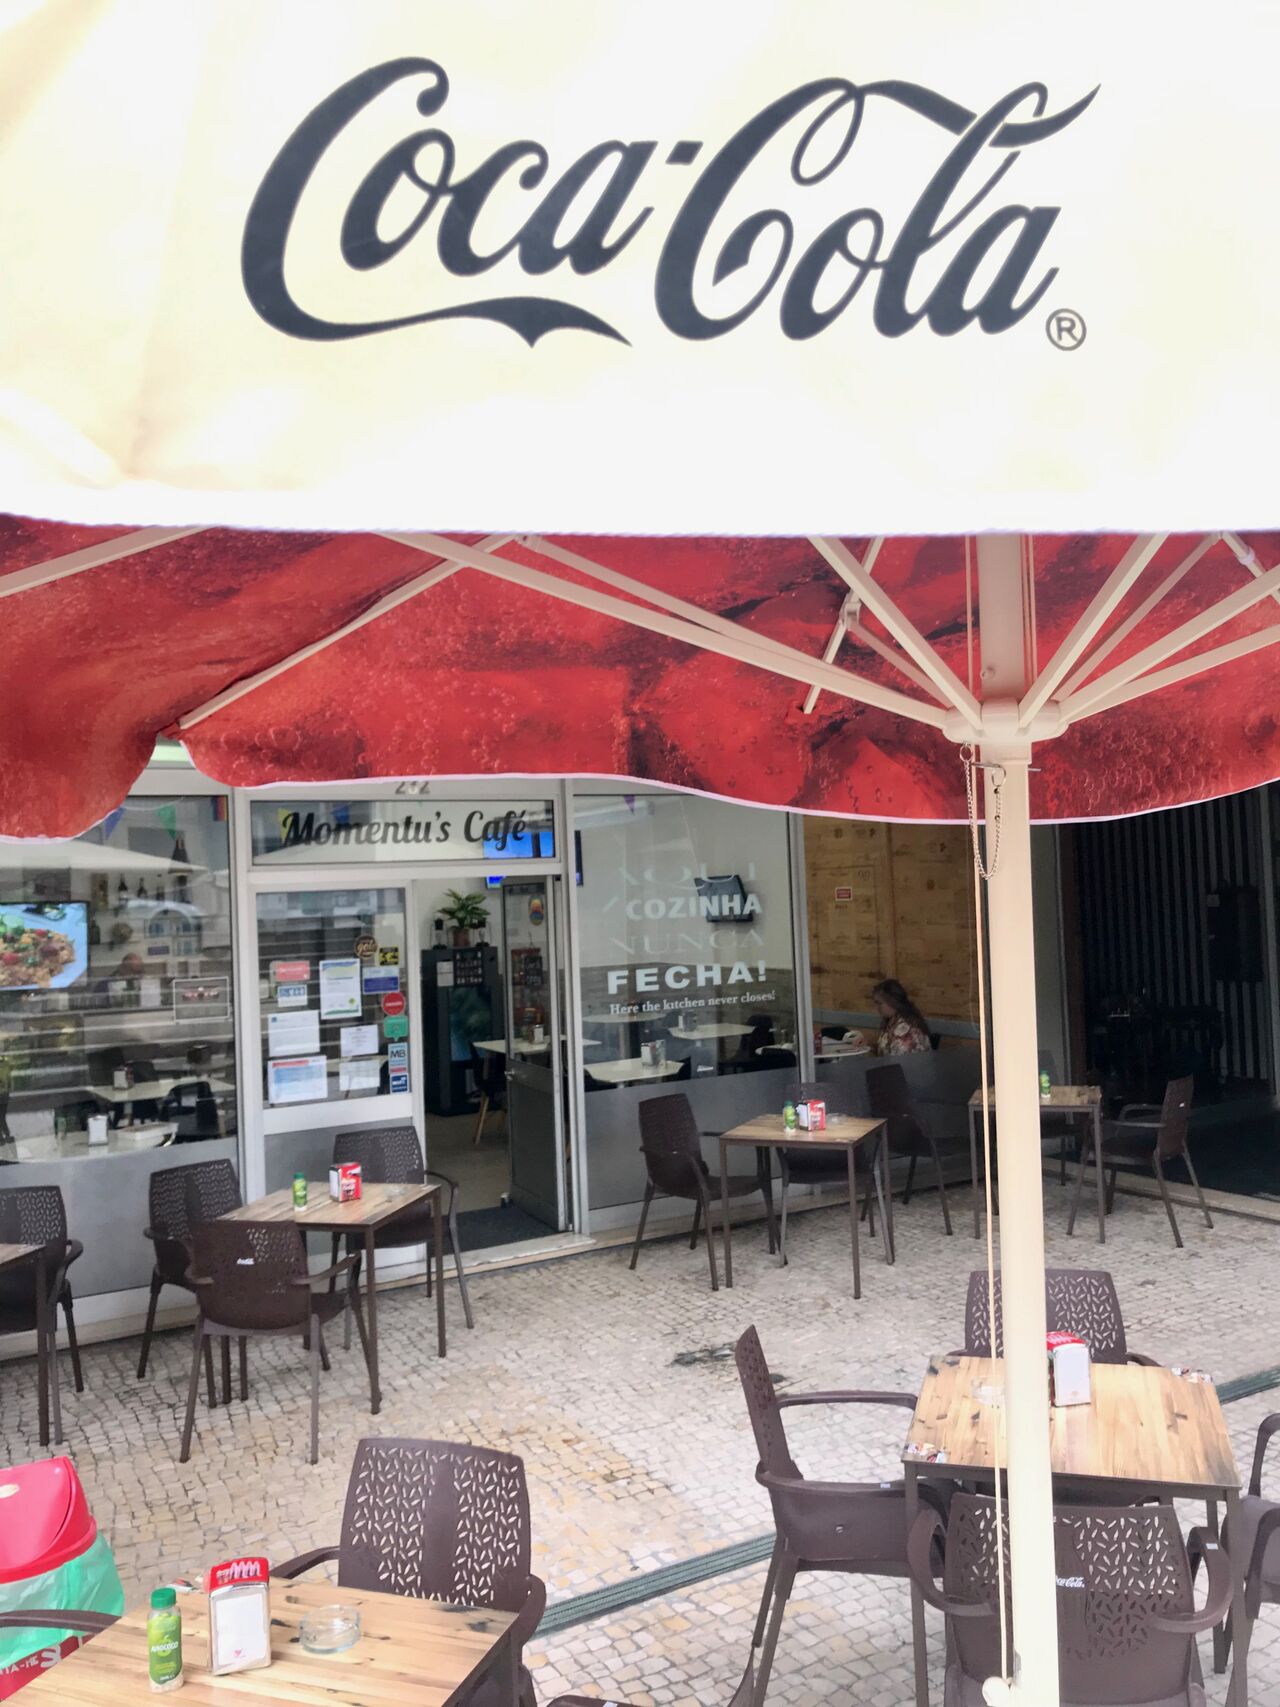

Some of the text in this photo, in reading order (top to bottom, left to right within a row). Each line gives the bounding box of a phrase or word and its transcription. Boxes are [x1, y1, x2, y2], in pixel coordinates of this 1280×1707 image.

[241, 57, 1102, 347] Coca-Cola
[281, 809, 527, 851] Momentu's Café
[625, 893, 763, 920] COZINHA
[607, 960, 767, 995] FECHA!
[609, 990, 777, 1015] Here the kitchen never closes!
